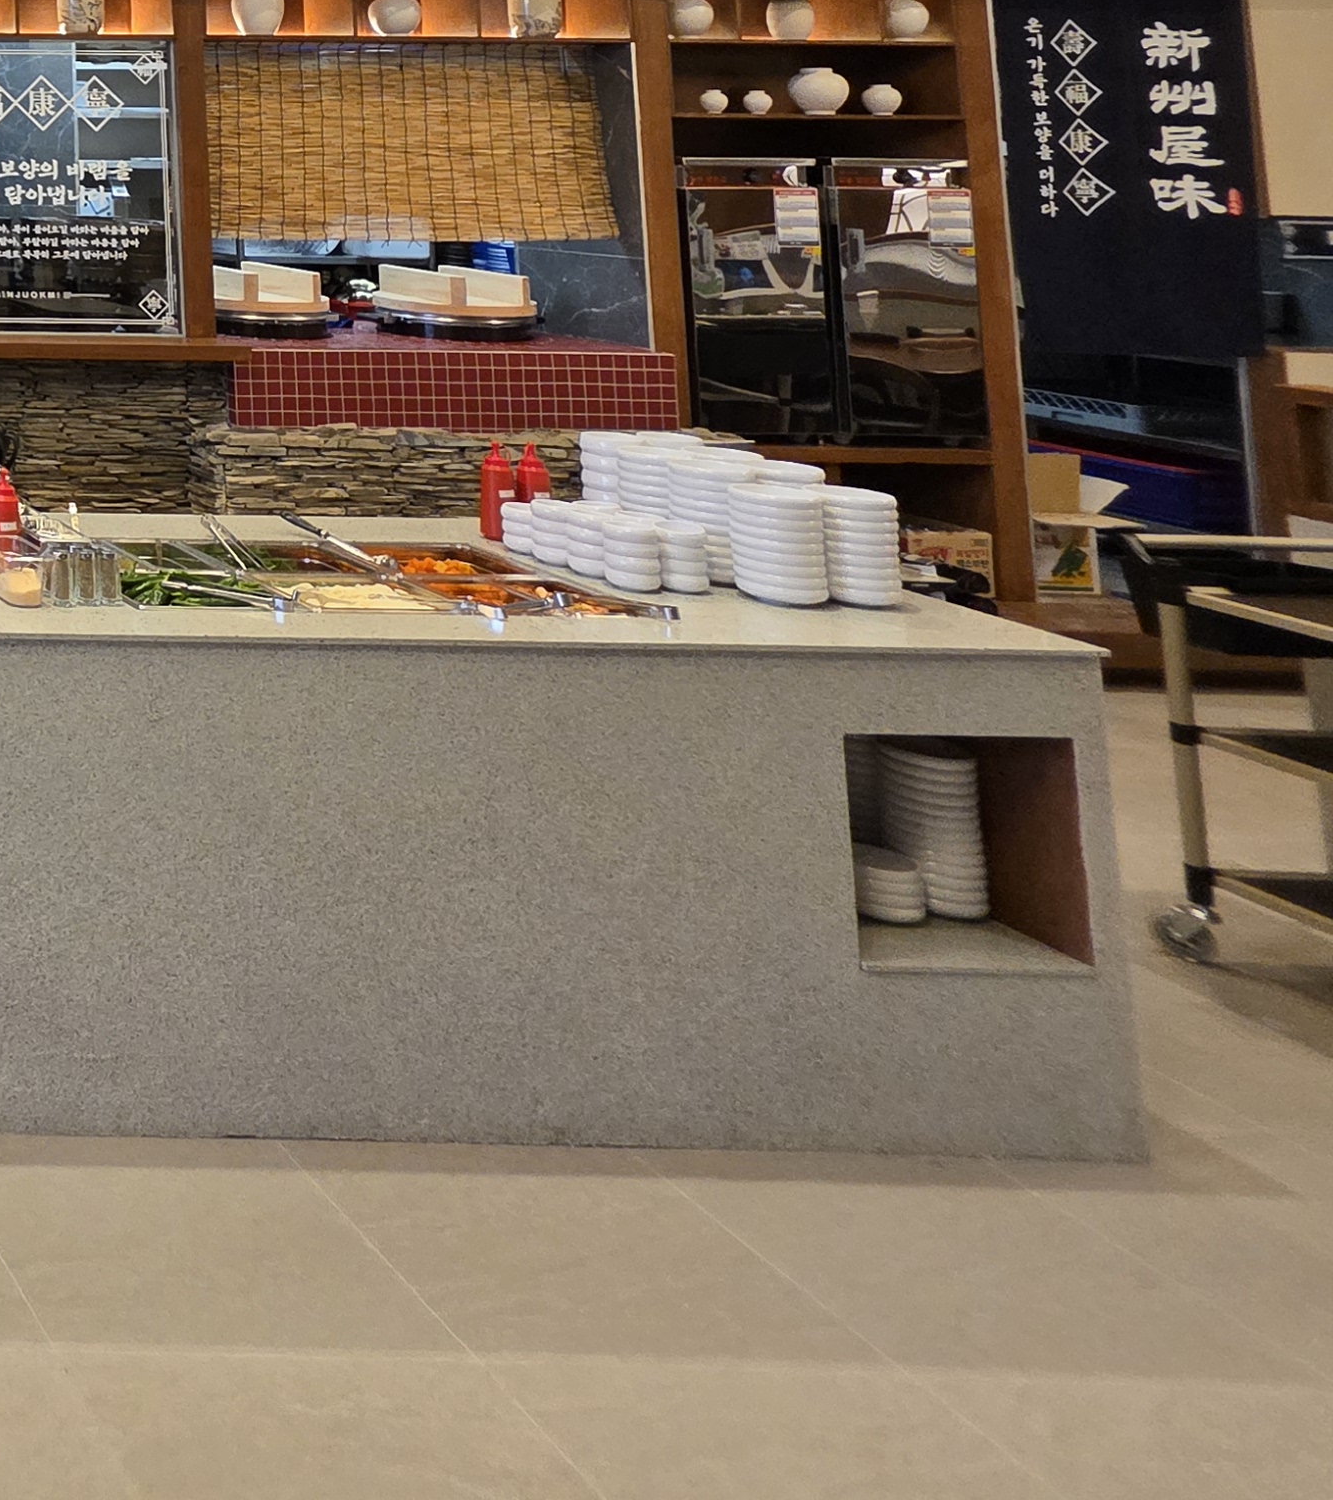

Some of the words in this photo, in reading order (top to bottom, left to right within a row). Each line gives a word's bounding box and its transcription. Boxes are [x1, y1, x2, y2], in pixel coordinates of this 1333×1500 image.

[1023, 17, 1043, 50] 온기
[1026, 56, 1050, 106] 가득한
[1033, 111, 1054, 160] 보양을
[1141, 21, 1228, 219] 新州屋味
[4, 184, 109, 206] 담아냅니다
